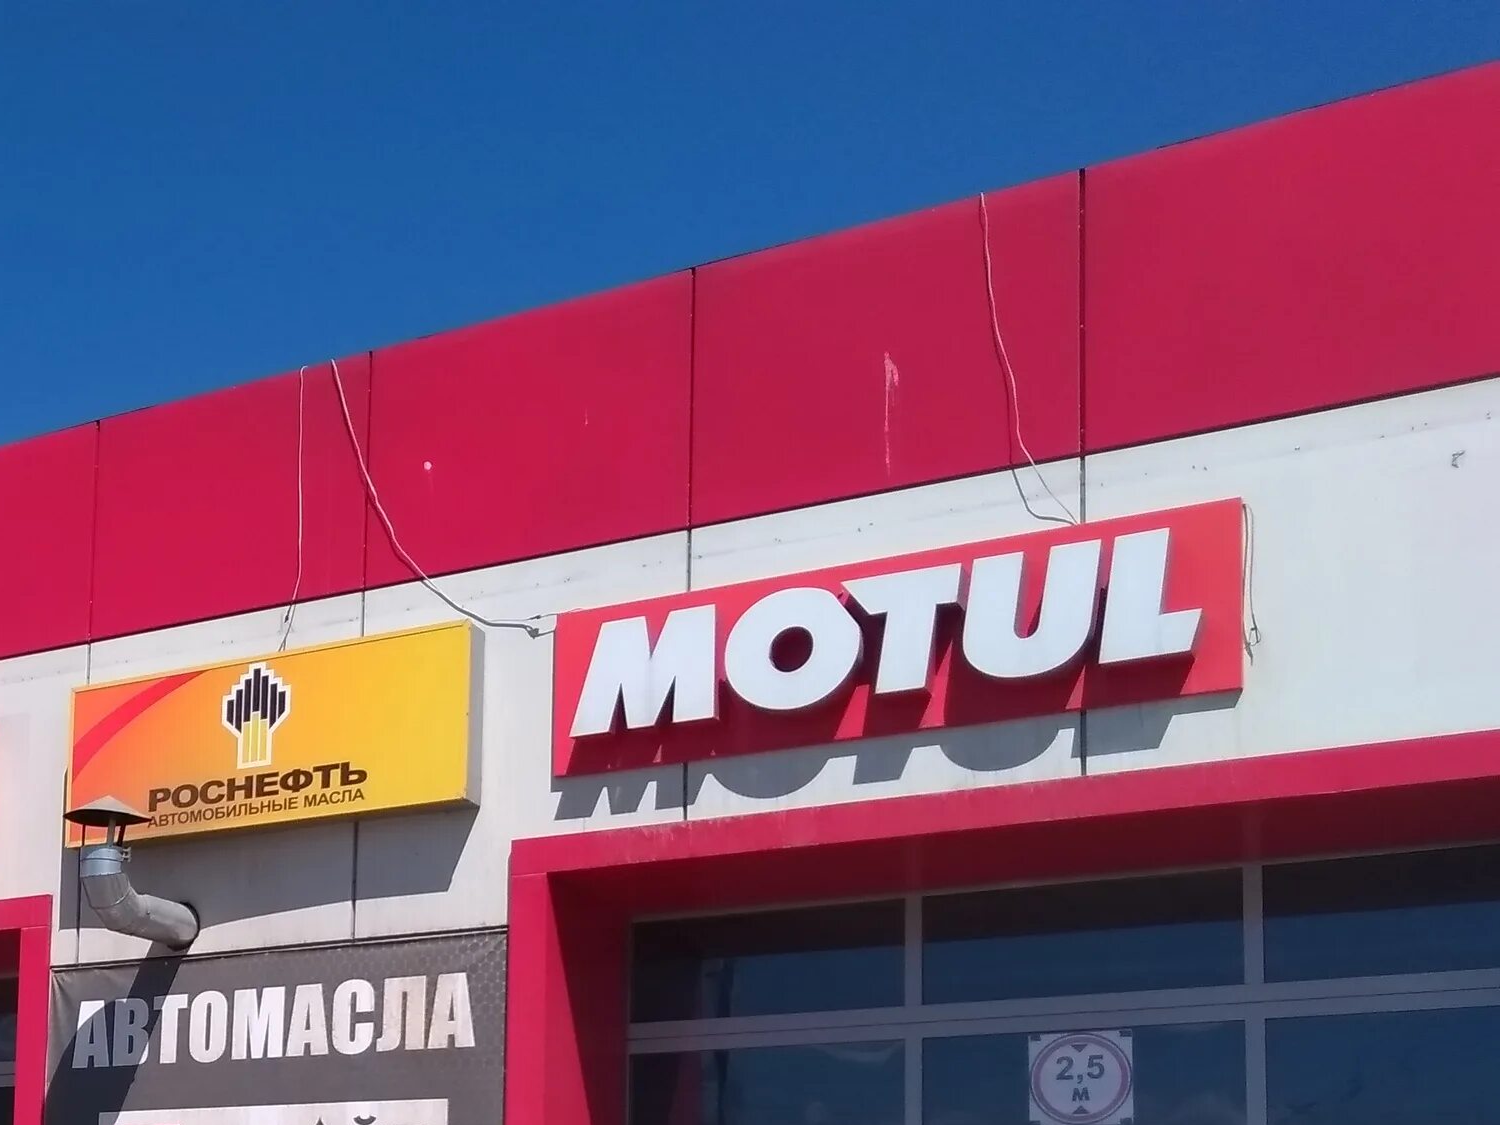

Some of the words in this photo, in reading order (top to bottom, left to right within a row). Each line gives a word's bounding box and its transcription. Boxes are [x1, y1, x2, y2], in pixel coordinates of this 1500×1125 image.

[569, 528, 1202, 740] MOTUL
[148, 761, 368, 812] РОСНЕФТЬ
[148, 797, 298, 829] АВТОМОБИЛЬНЫЕ
[303, 787, 365, 808] МАСЛА
[72, 972, 475, 1068] АВТОМАСЛА
[1056, 1055, 1104, 1083] 2,5
